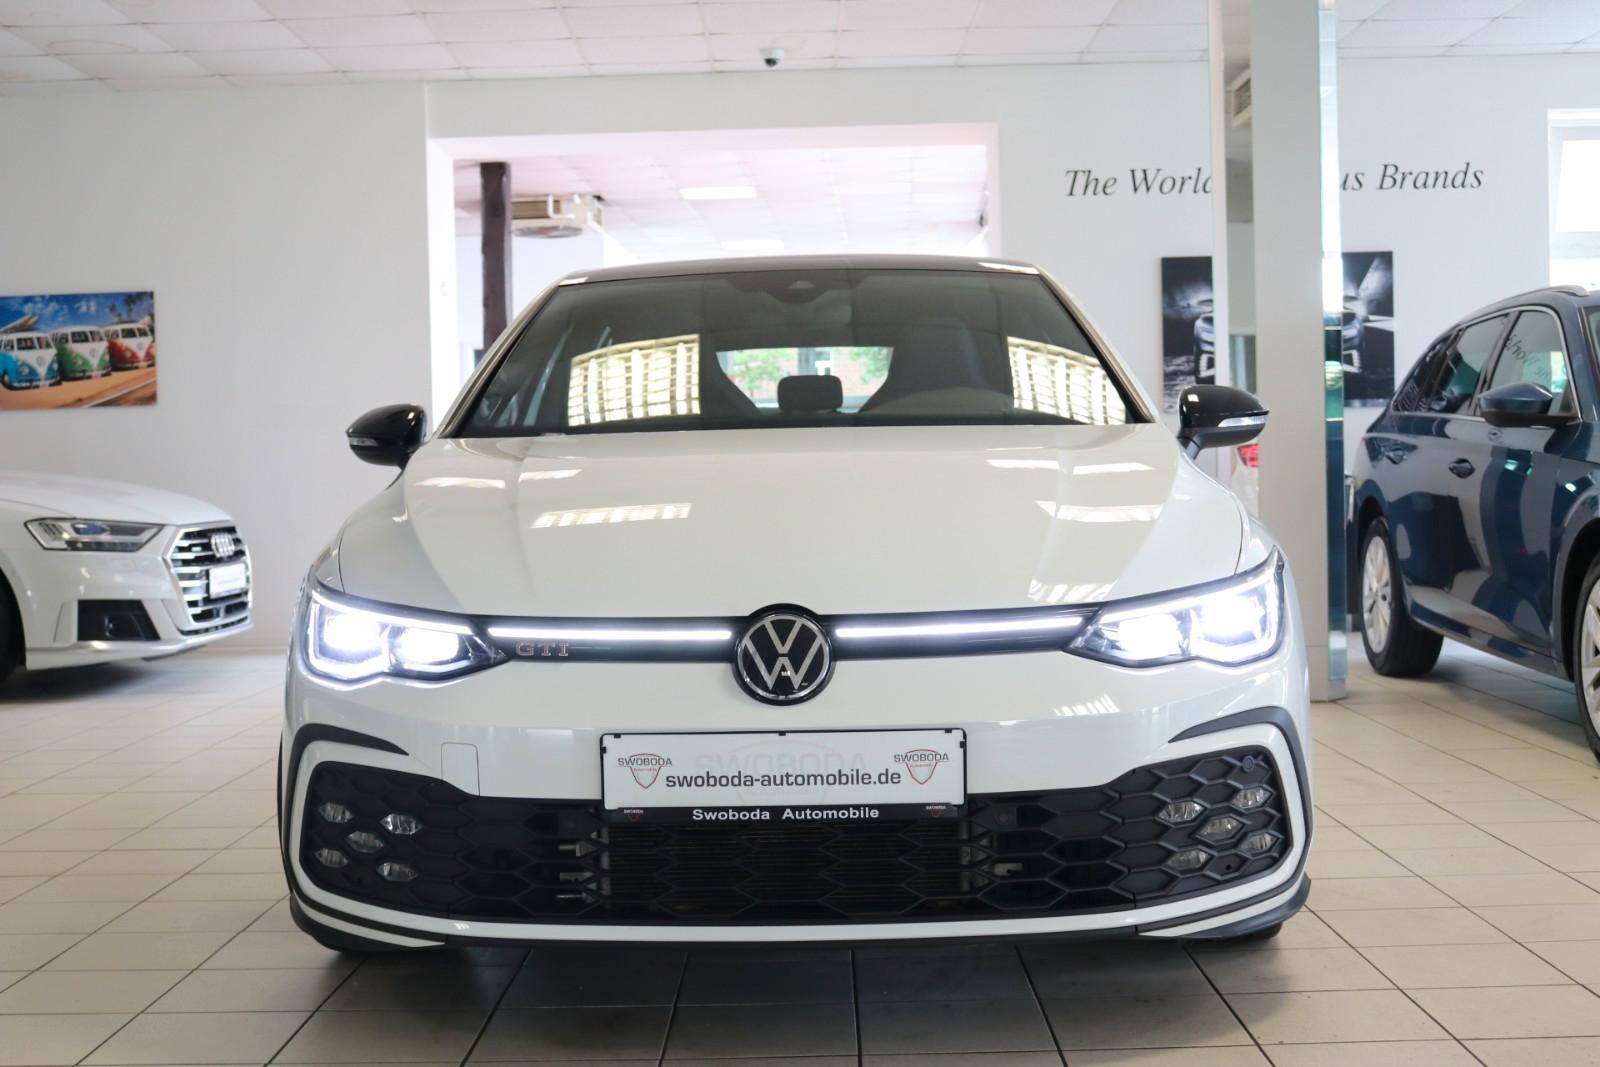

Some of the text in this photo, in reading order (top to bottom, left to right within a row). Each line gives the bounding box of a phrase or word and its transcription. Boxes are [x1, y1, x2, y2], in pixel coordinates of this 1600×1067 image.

[1064, 168, 1118, 197] The
[1376, 161, 1485, 191] Brands
[514, 639, 570, 657] GTI
[617, 757, 673, 767] SWOBODA
[893, 752, 950, 763] SWOBODA
[665, 767, 902, 788] swoboda-automobile.de
[692, 806, 880, 821] Swoboda Automobile
